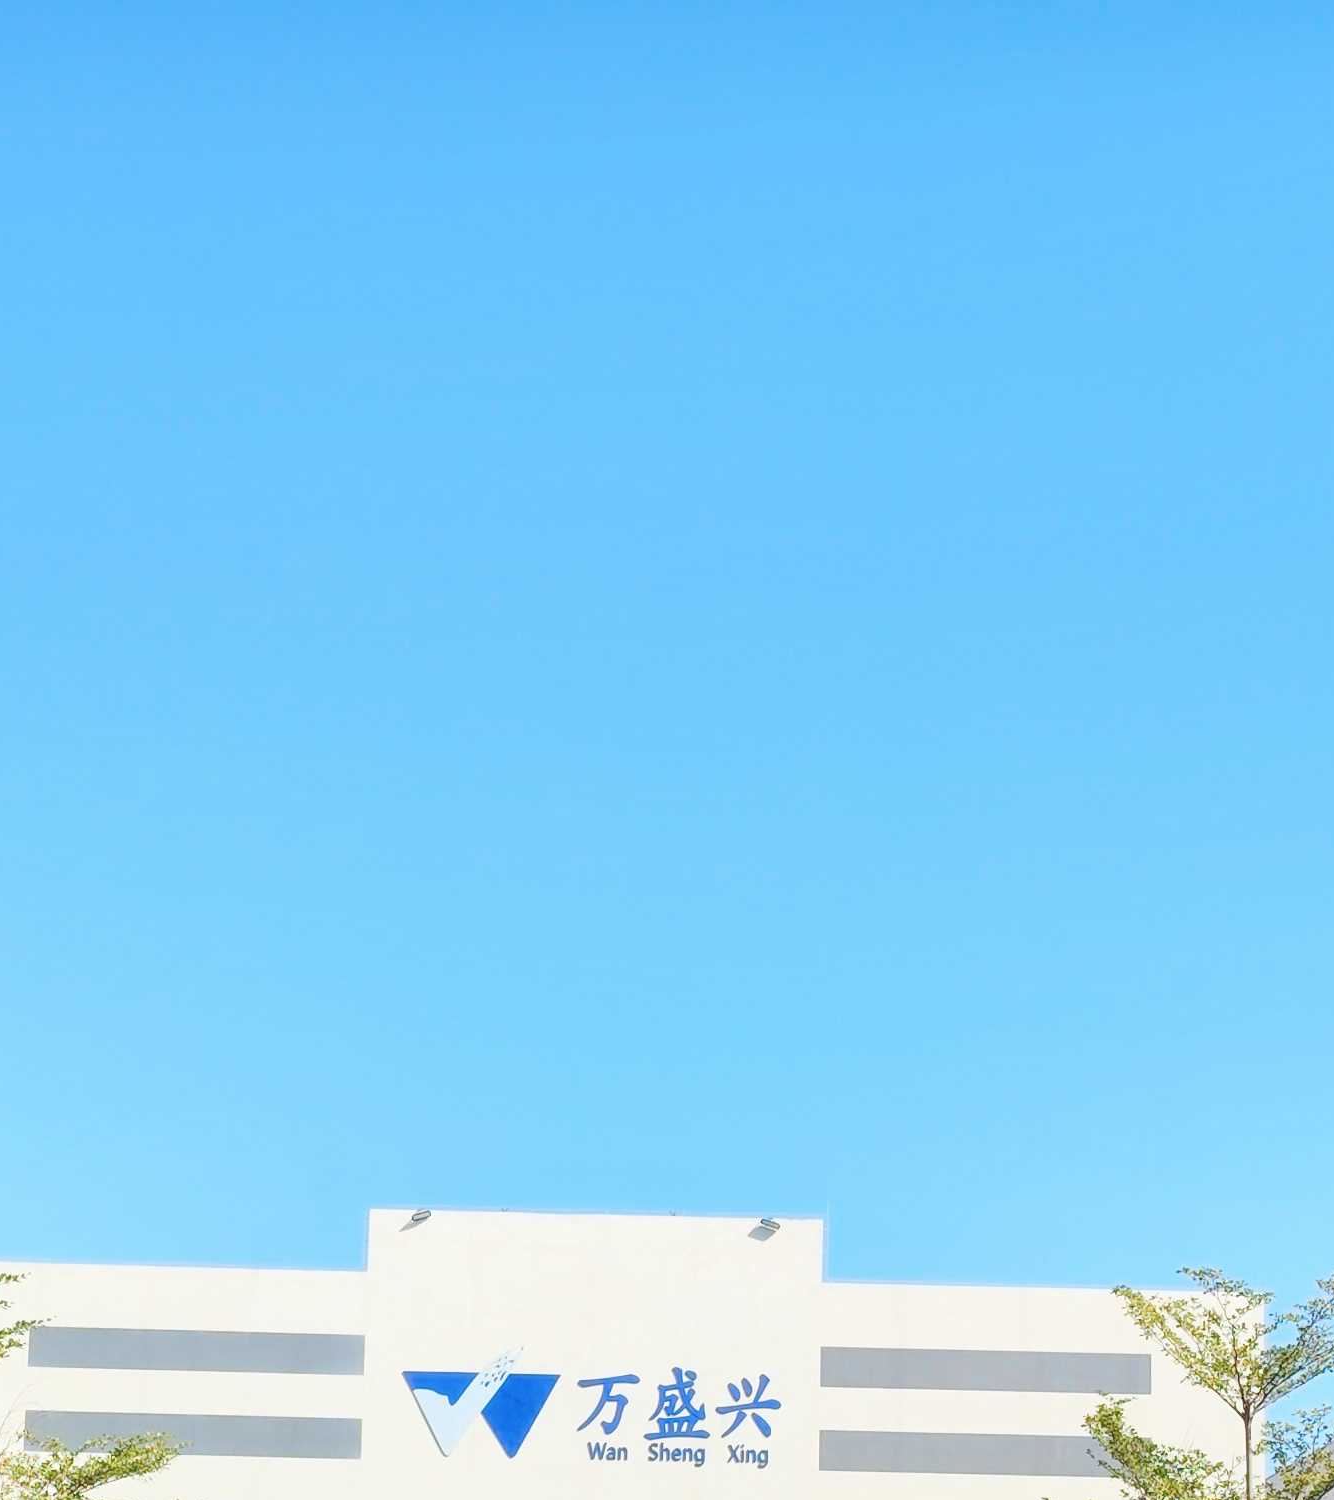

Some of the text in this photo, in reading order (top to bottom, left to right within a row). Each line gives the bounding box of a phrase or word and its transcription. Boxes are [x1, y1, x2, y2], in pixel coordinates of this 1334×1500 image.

[576, 1366, 781, 1440] 万盛兴
[586, 1442, 769, 1469] Wan Sheng Xing
